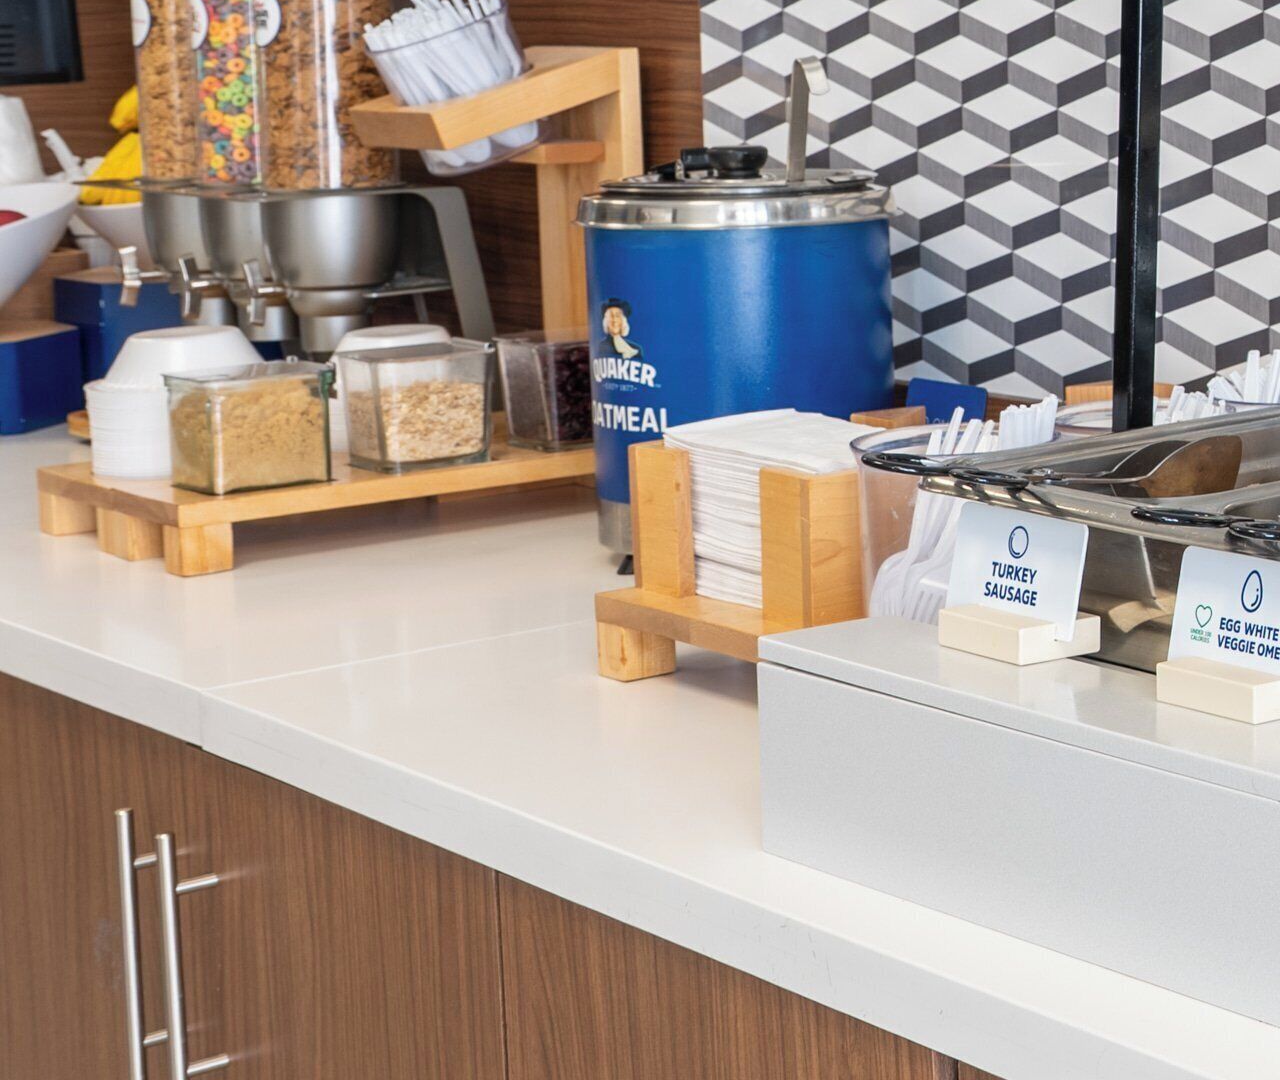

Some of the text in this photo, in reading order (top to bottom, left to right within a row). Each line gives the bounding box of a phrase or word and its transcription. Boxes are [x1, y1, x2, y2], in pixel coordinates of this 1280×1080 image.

[592, 357, 657, 388] QUAKER
[991, 561, 1038, 585] TURKEY
[983, 581, 1038, 607] SAUSAGE
[1219, 617, 1242, 633] EGG
[1244, 621, 1280, 641] WHITE
[1217, 634, 1256, 655] VEGGIE
